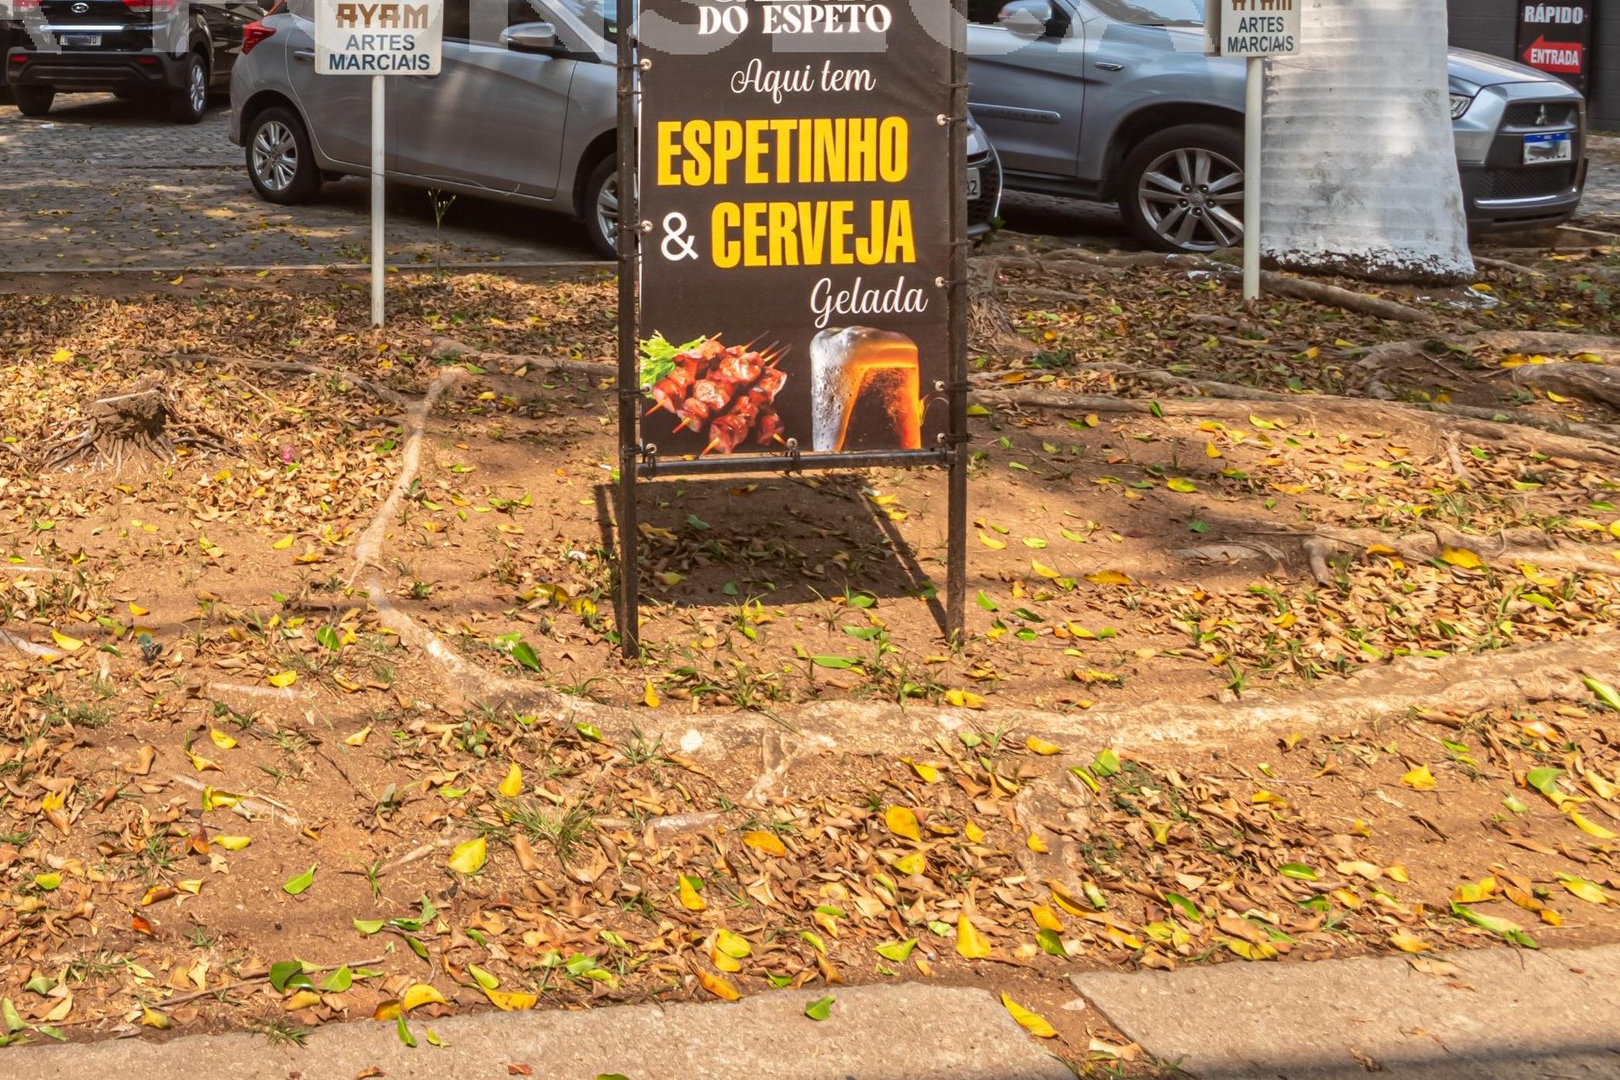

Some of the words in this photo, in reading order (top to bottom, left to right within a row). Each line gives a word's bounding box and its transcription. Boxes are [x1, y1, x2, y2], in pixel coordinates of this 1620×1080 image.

[335, 4, 429, 29] AYAM
[698, 5, 749, 35] DO
[762, 4, 892, 34] ESPETO
[1238, 17, 1284, 33] ARTES
[1524, 3, 1584, 24] RÁPIDO
[345, 34, 415, 51] ARTES
[1227, 35, 1294, 53] MARCIAIS
[329, 54, 430, 70] MARCIAIS
[1530, 48, 1579, 66] ENTRADA
[731, 58, 815, 104] Aqui
[821, 60, 877, 92] tem
[657, 116, 909, 187] ESPETINHO
[660, 211, 699, 261] &
[711, 199, 916, 268] CERVEJA
[810, 276, 929, 328] Gelada
